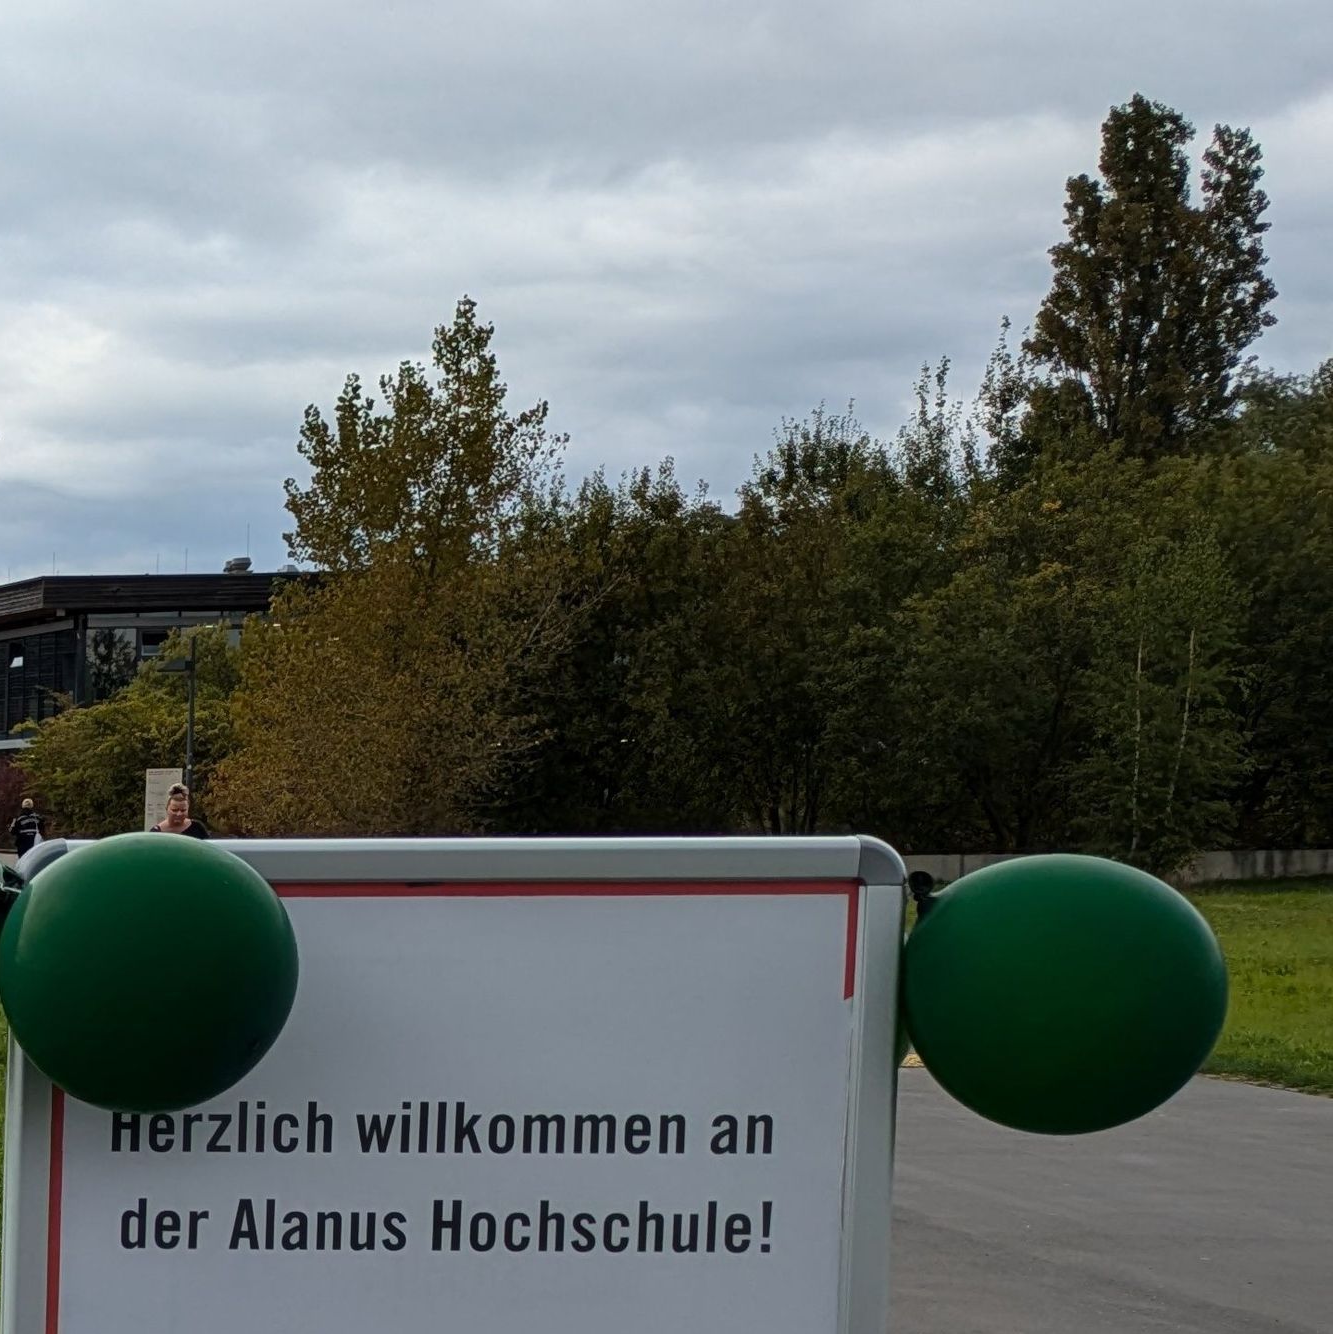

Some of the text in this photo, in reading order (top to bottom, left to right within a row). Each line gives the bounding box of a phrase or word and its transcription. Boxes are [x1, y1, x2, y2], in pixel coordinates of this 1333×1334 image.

[111, 1100, 774, 1155] Herzlich willkommen an
[120, 1197, 773, 1254] der Alanus Hochschule!
